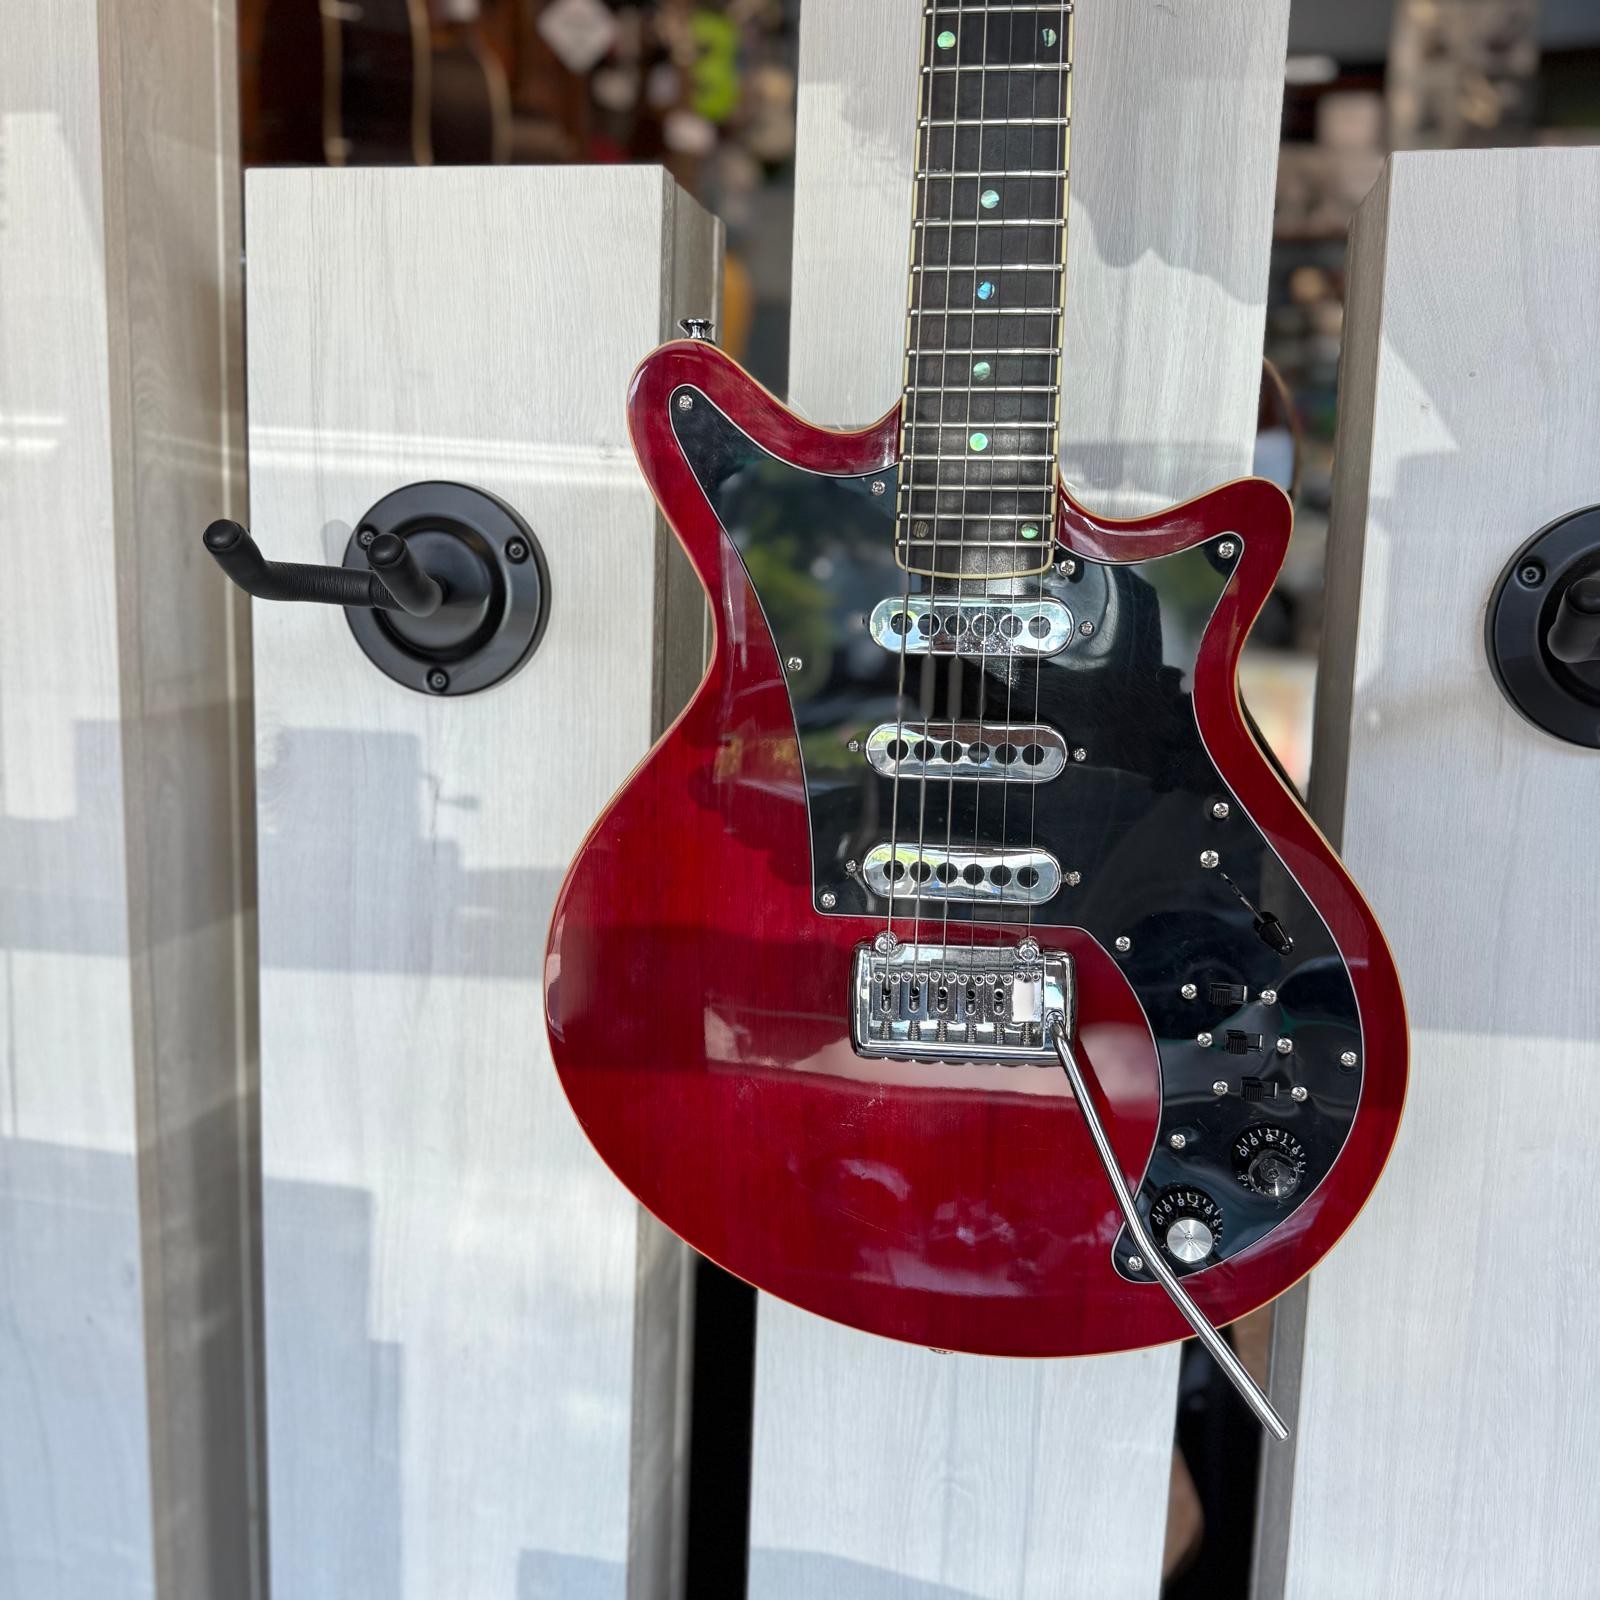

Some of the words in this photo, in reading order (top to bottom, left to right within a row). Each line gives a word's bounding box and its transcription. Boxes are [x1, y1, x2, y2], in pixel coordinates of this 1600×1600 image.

[1250, 1137, 1259, 1146] 9
[1265, 1133, 1274, 1142] 8
[1239, 1145, 1250, 1157] 10
[1177, 1198, 1185, 1207] 8
[1164, 1204, 1172, 1213] 9
[1156, 1213, 1165, 1225] 10
